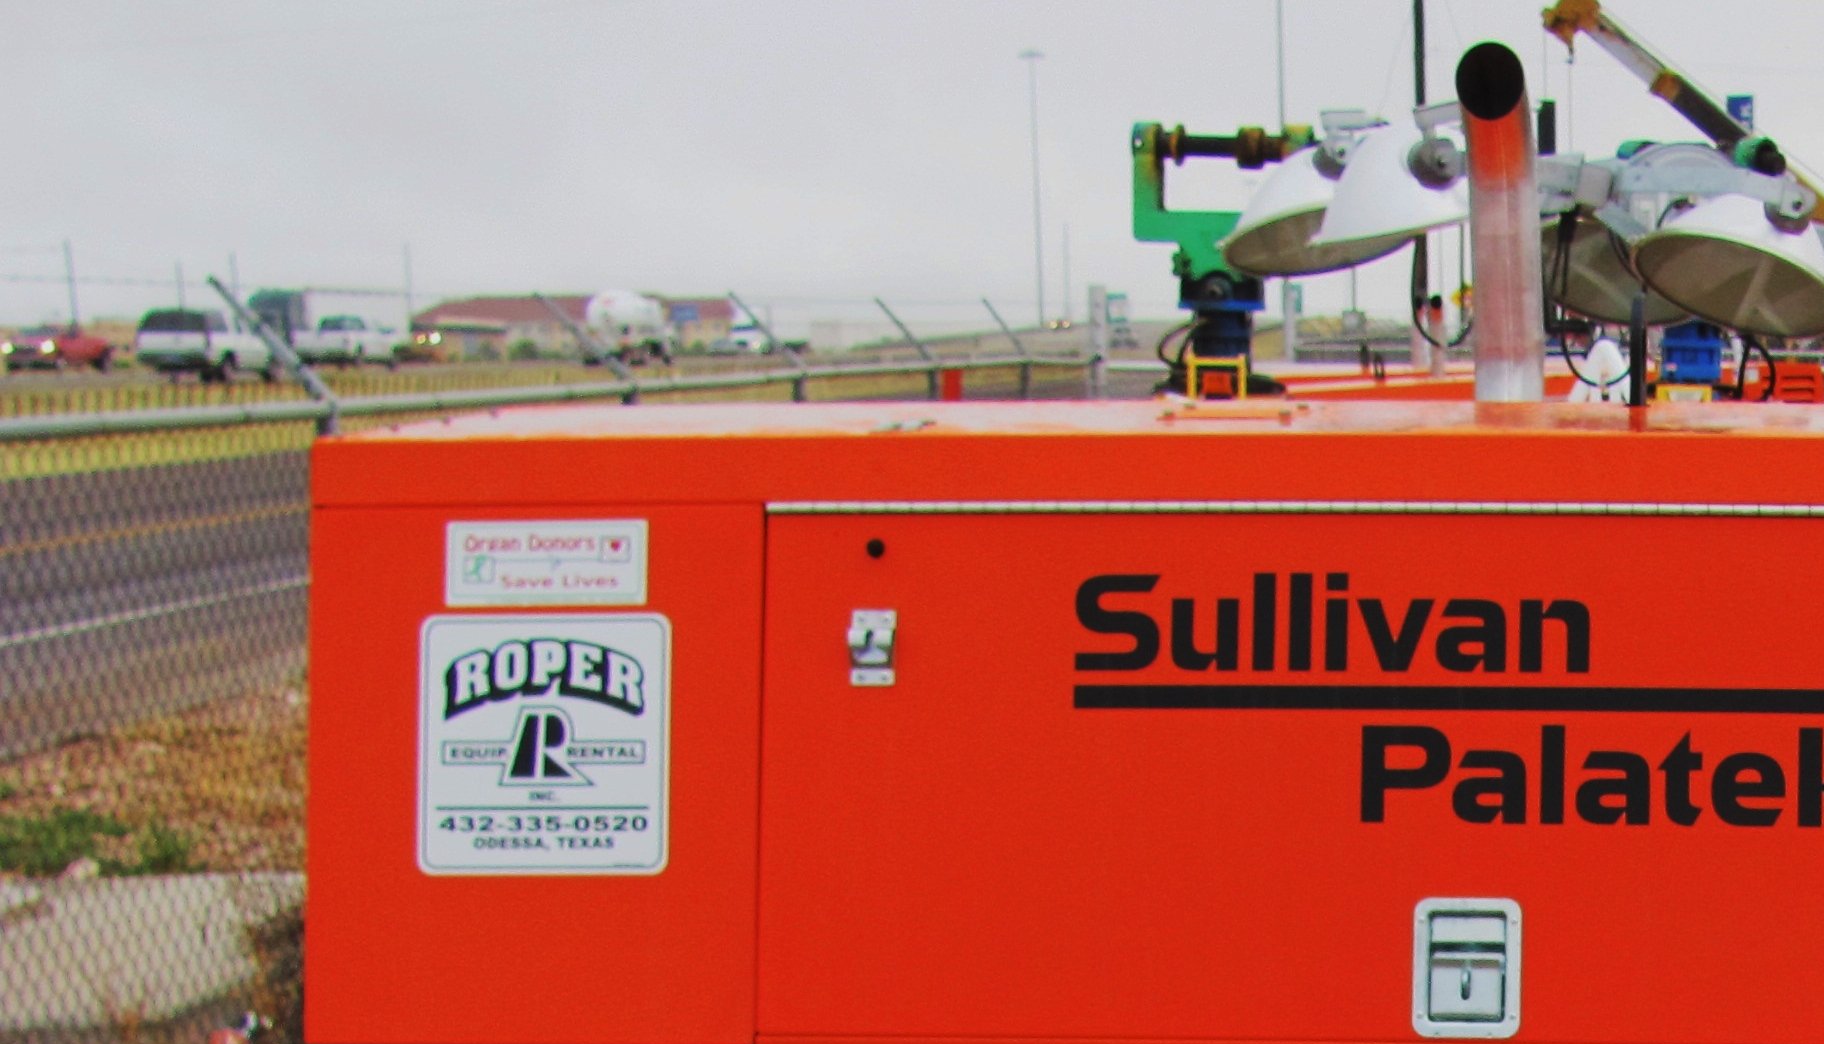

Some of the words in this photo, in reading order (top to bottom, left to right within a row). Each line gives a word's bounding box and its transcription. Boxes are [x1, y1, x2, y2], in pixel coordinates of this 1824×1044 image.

[465, 534, 521, 553] Organ
[529, 534, 595, 551] Donors
[502, 575, 552, 588] Save
[562, 575, 618, 588] Lives
[1074, 573, 1591, 674] Sullivan
[444, 638, 645, 720] ROPER
[450, 746, 506, 759] EQUIP
[566, 746, 638, 758] RENTAL
[438, 814, 649, 833] 432-335-0520
[557, 836, 615, 849] TEXAS
